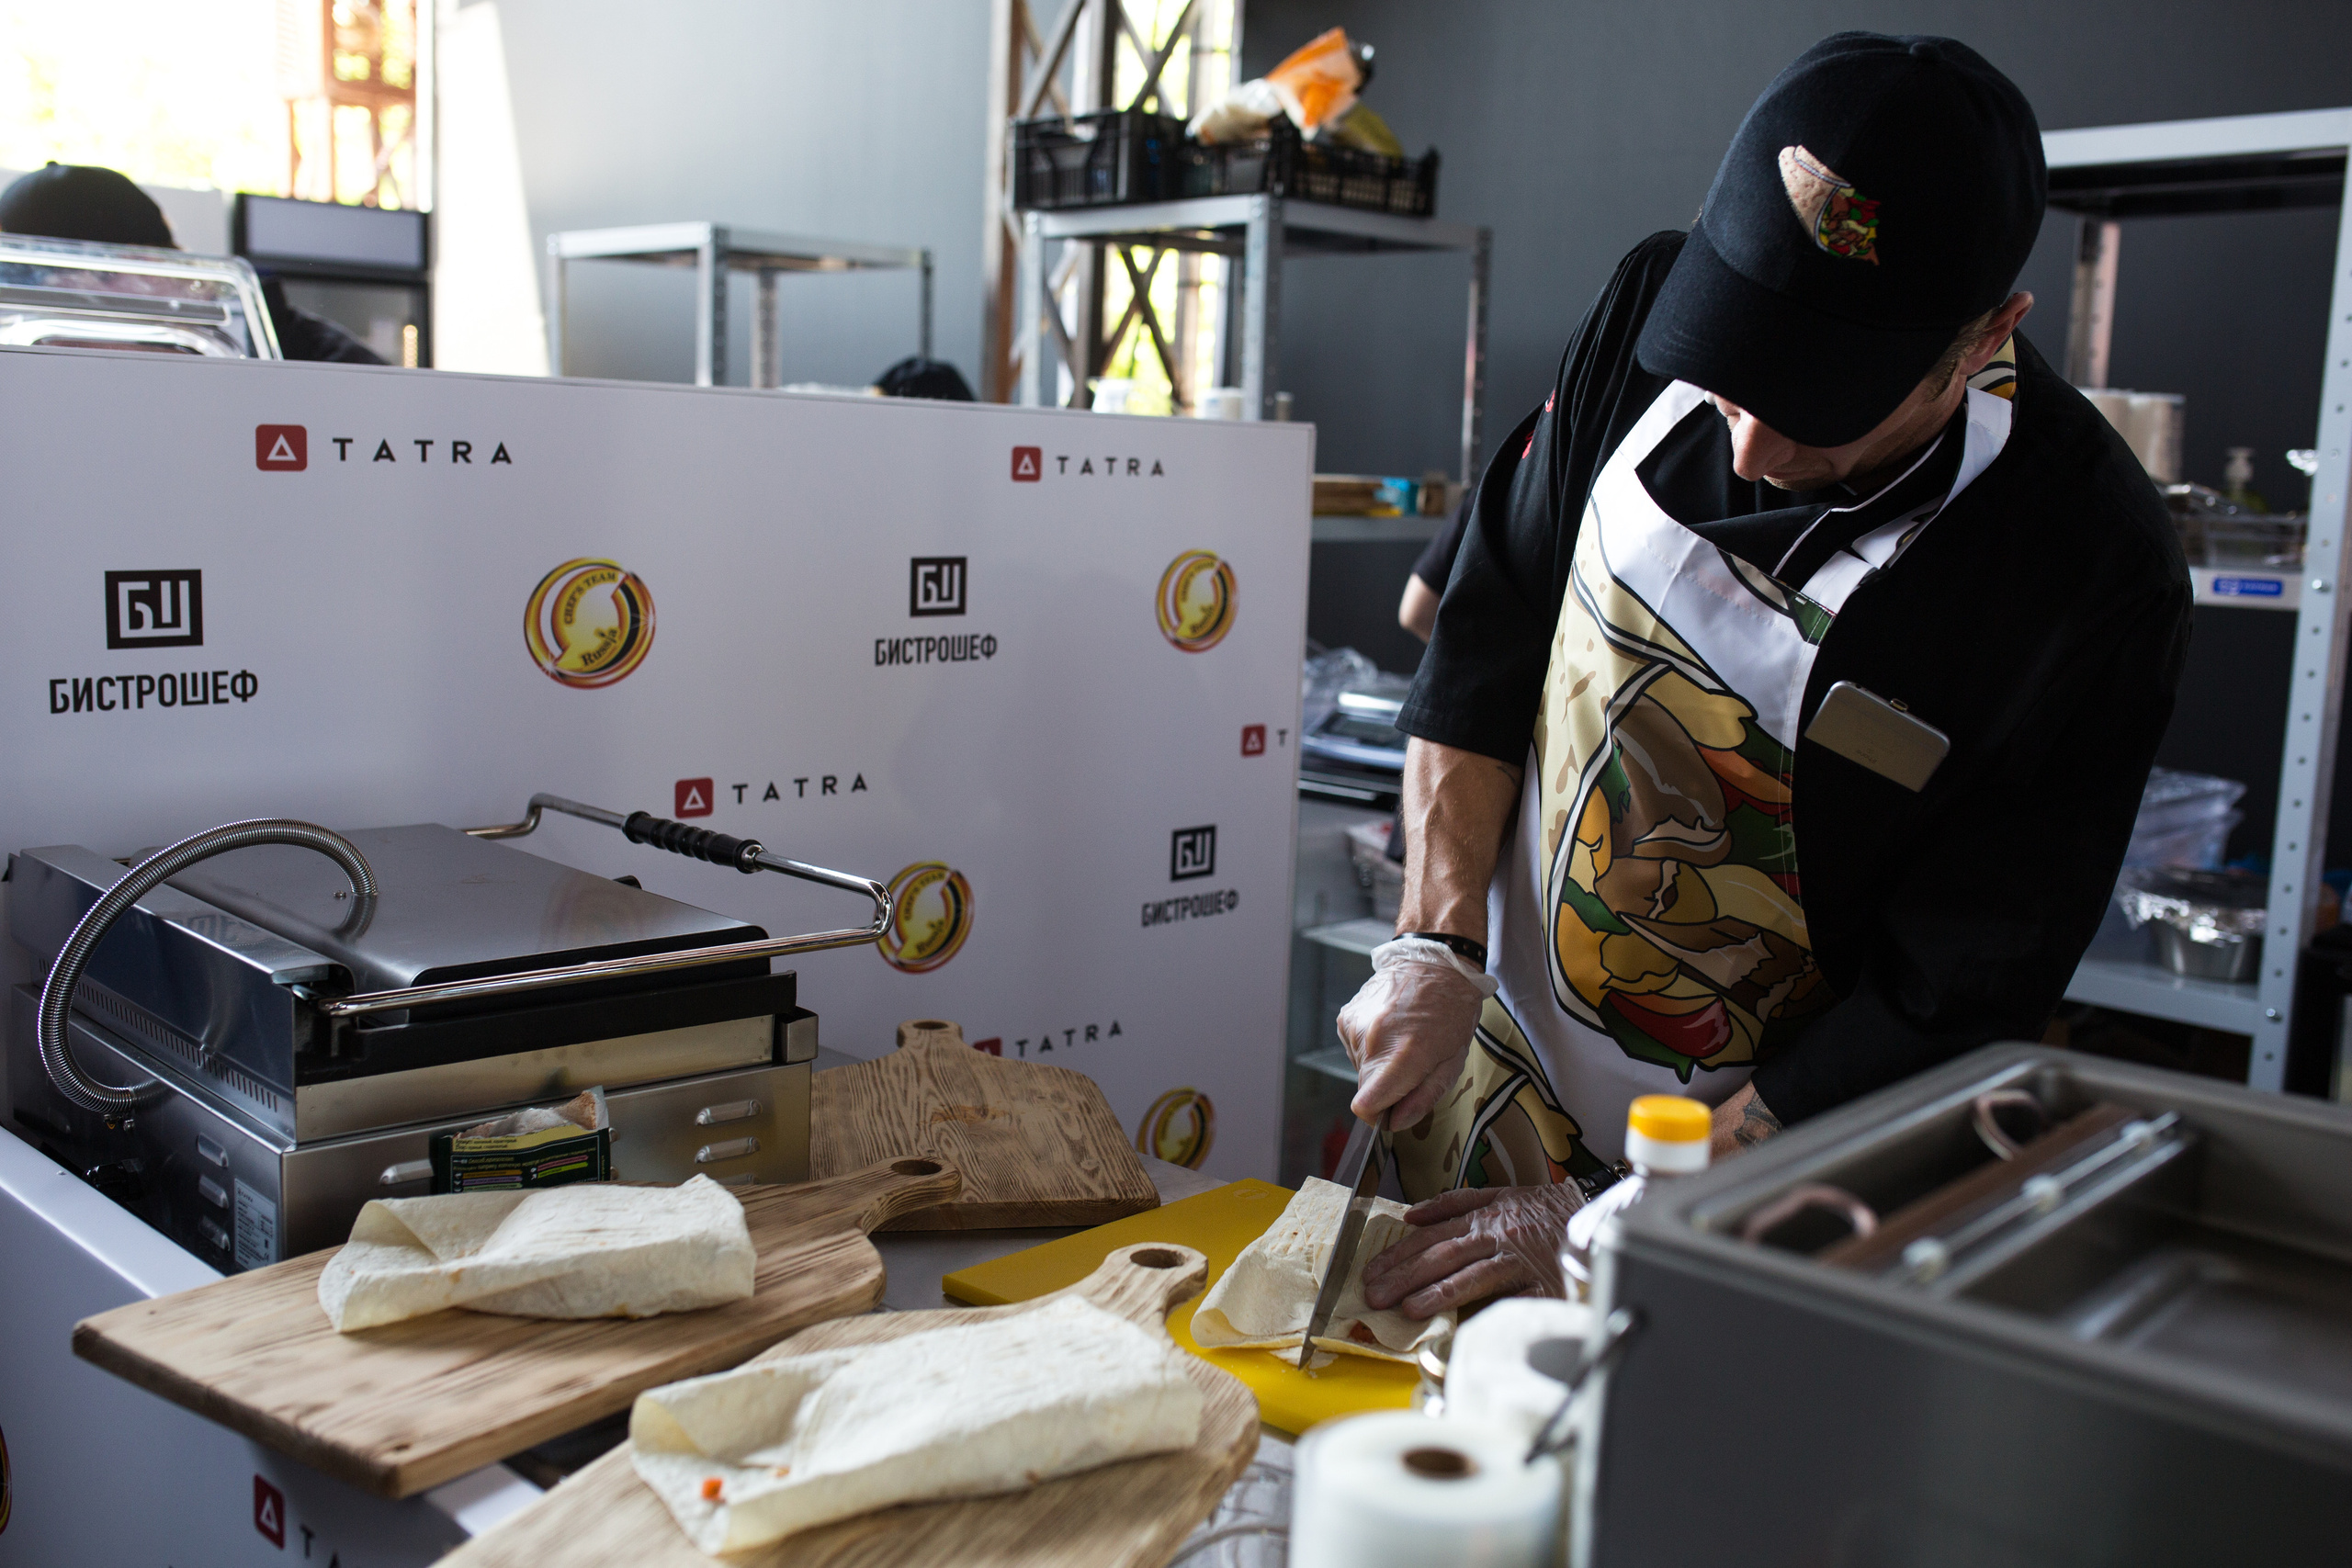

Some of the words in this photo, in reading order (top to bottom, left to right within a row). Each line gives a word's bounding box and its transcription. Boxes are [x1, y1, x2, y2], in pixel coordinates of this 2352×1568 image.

[332, 437, 513, 465] TATRA
[1057, 456, 1165, 478] TATRA
[583, 571, 616, 588] TEAM
[875, 633, 999, 667] БИСТРОШЕФ
[49, 669, 258, 715] БИСТРОШЕФ
[731, 773, 868, 805] TATRA
[1141, 888, 1239, 929] БИСТРОШЕФ
[1015, 1020, 1123, 1058] TATRA
